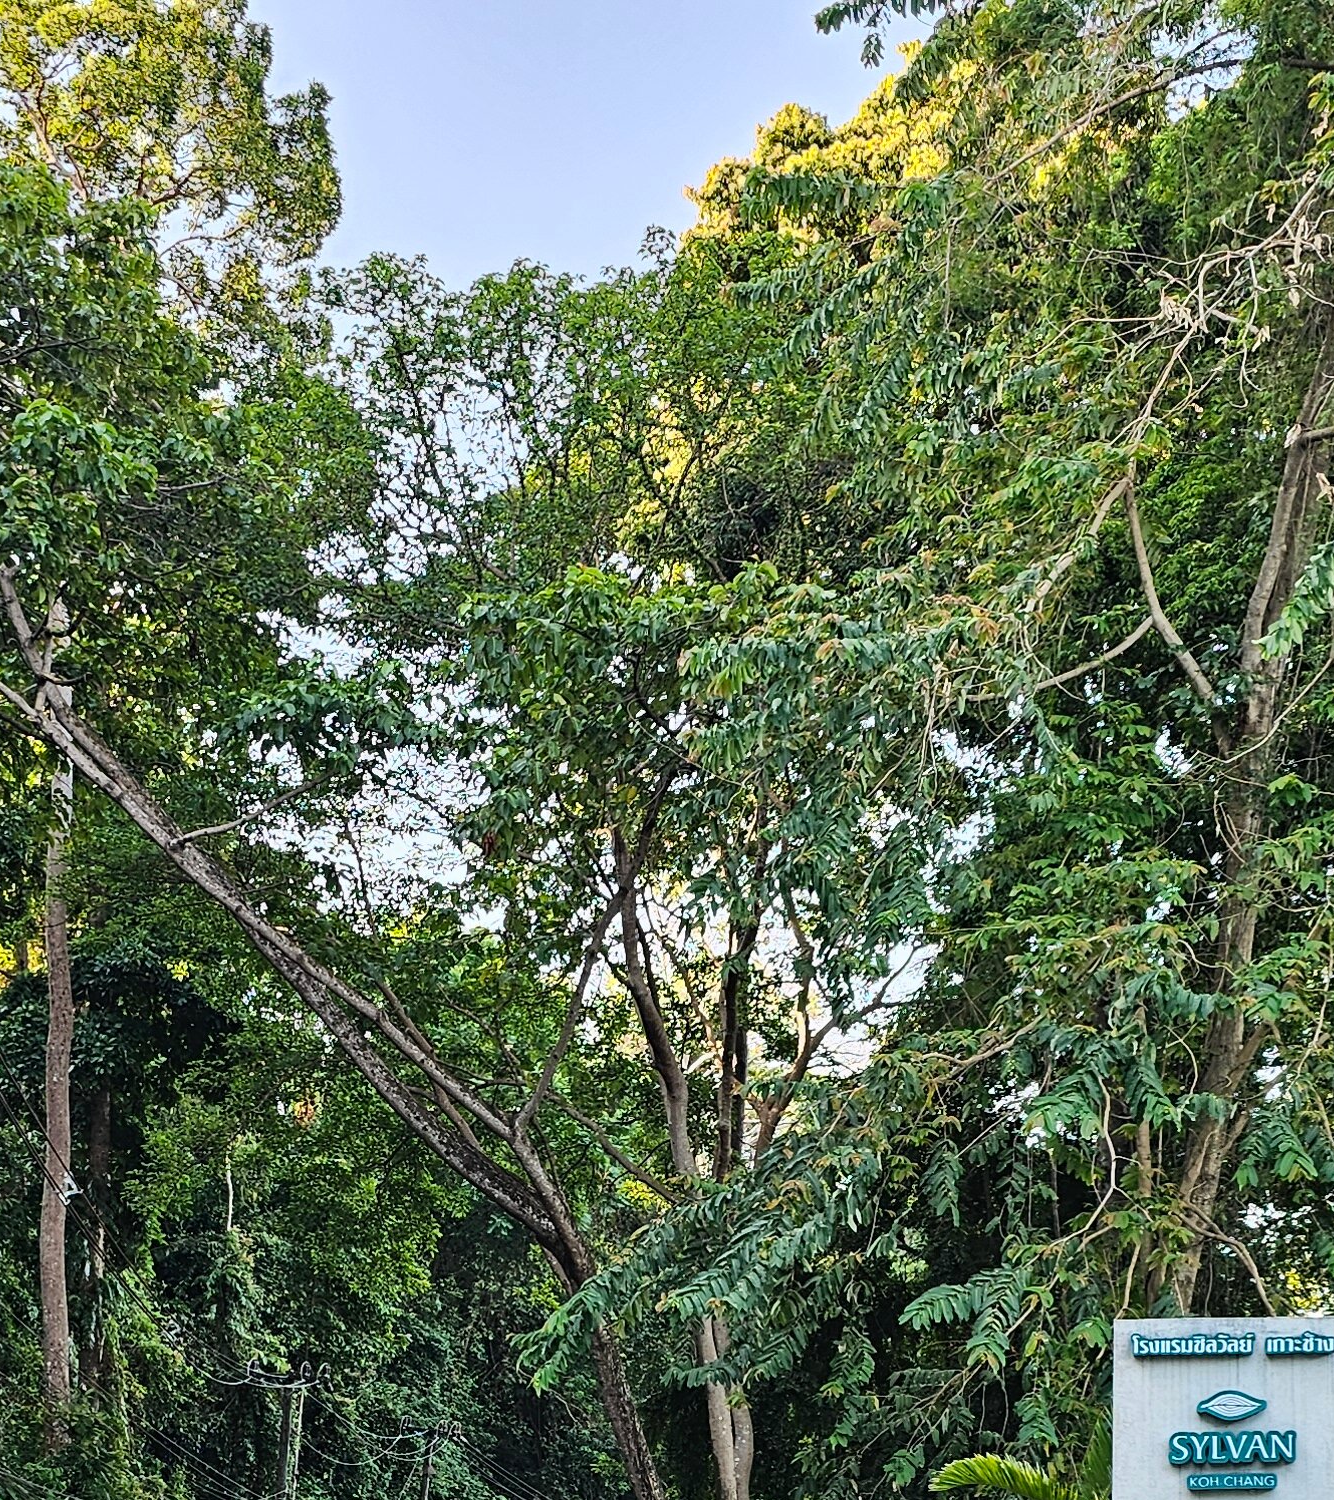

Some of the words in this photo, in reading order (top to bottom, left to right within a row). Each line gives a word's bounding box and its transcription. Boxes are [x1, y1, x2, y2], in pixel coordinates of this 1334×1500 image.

[1266, 1332, 1334, 1353] เกาะช้าง
[1170, 1433, 1294, 1461] SYLVAN
[1189, 1476, 1219, 1488] KOH
[1223, 1475, 1275, 1487] CHANG
